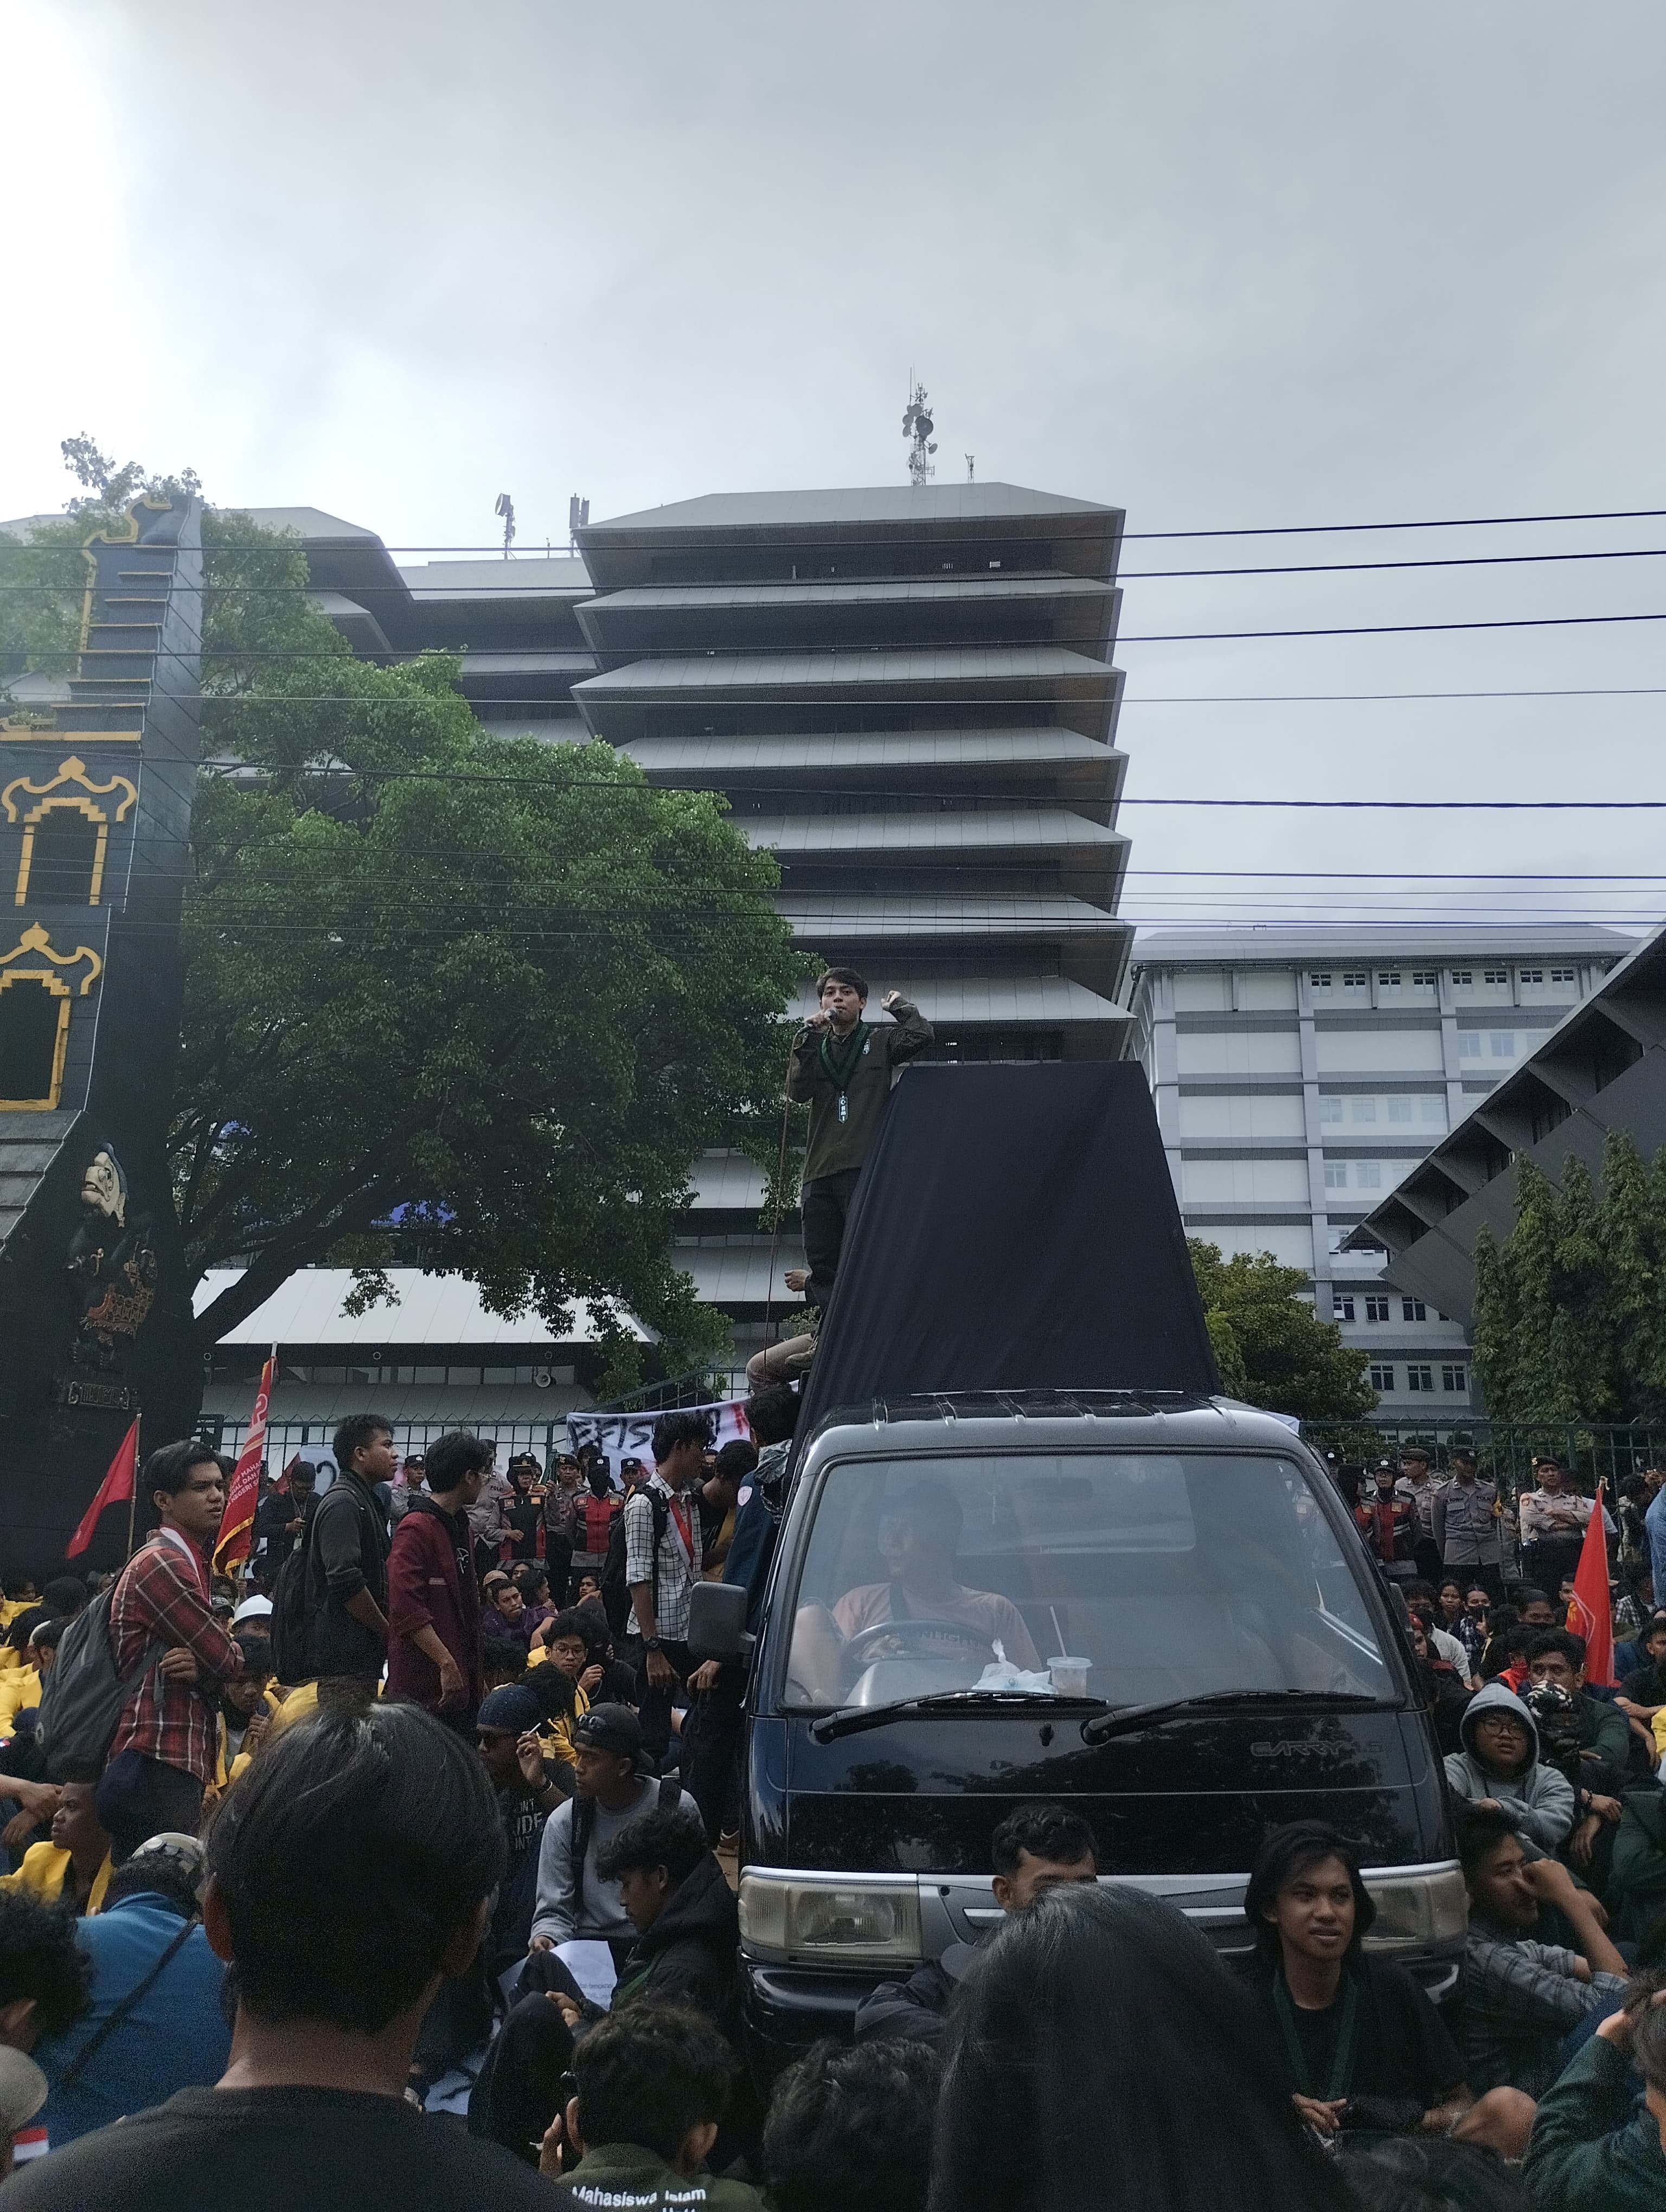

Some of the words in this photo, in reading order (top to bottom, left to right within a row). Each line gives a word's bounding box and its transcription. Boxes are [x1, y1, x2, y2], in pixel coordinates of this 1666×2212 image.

[242, 1472, 257, 1484] DAN
[231, 1483, 253, 1503] NEGERI
[1250, 1740, 1346, 1757] CARRY
[572, 2185, 657, 2207] Mahasiswa
[665, 2188, 706, 2202] Islam
